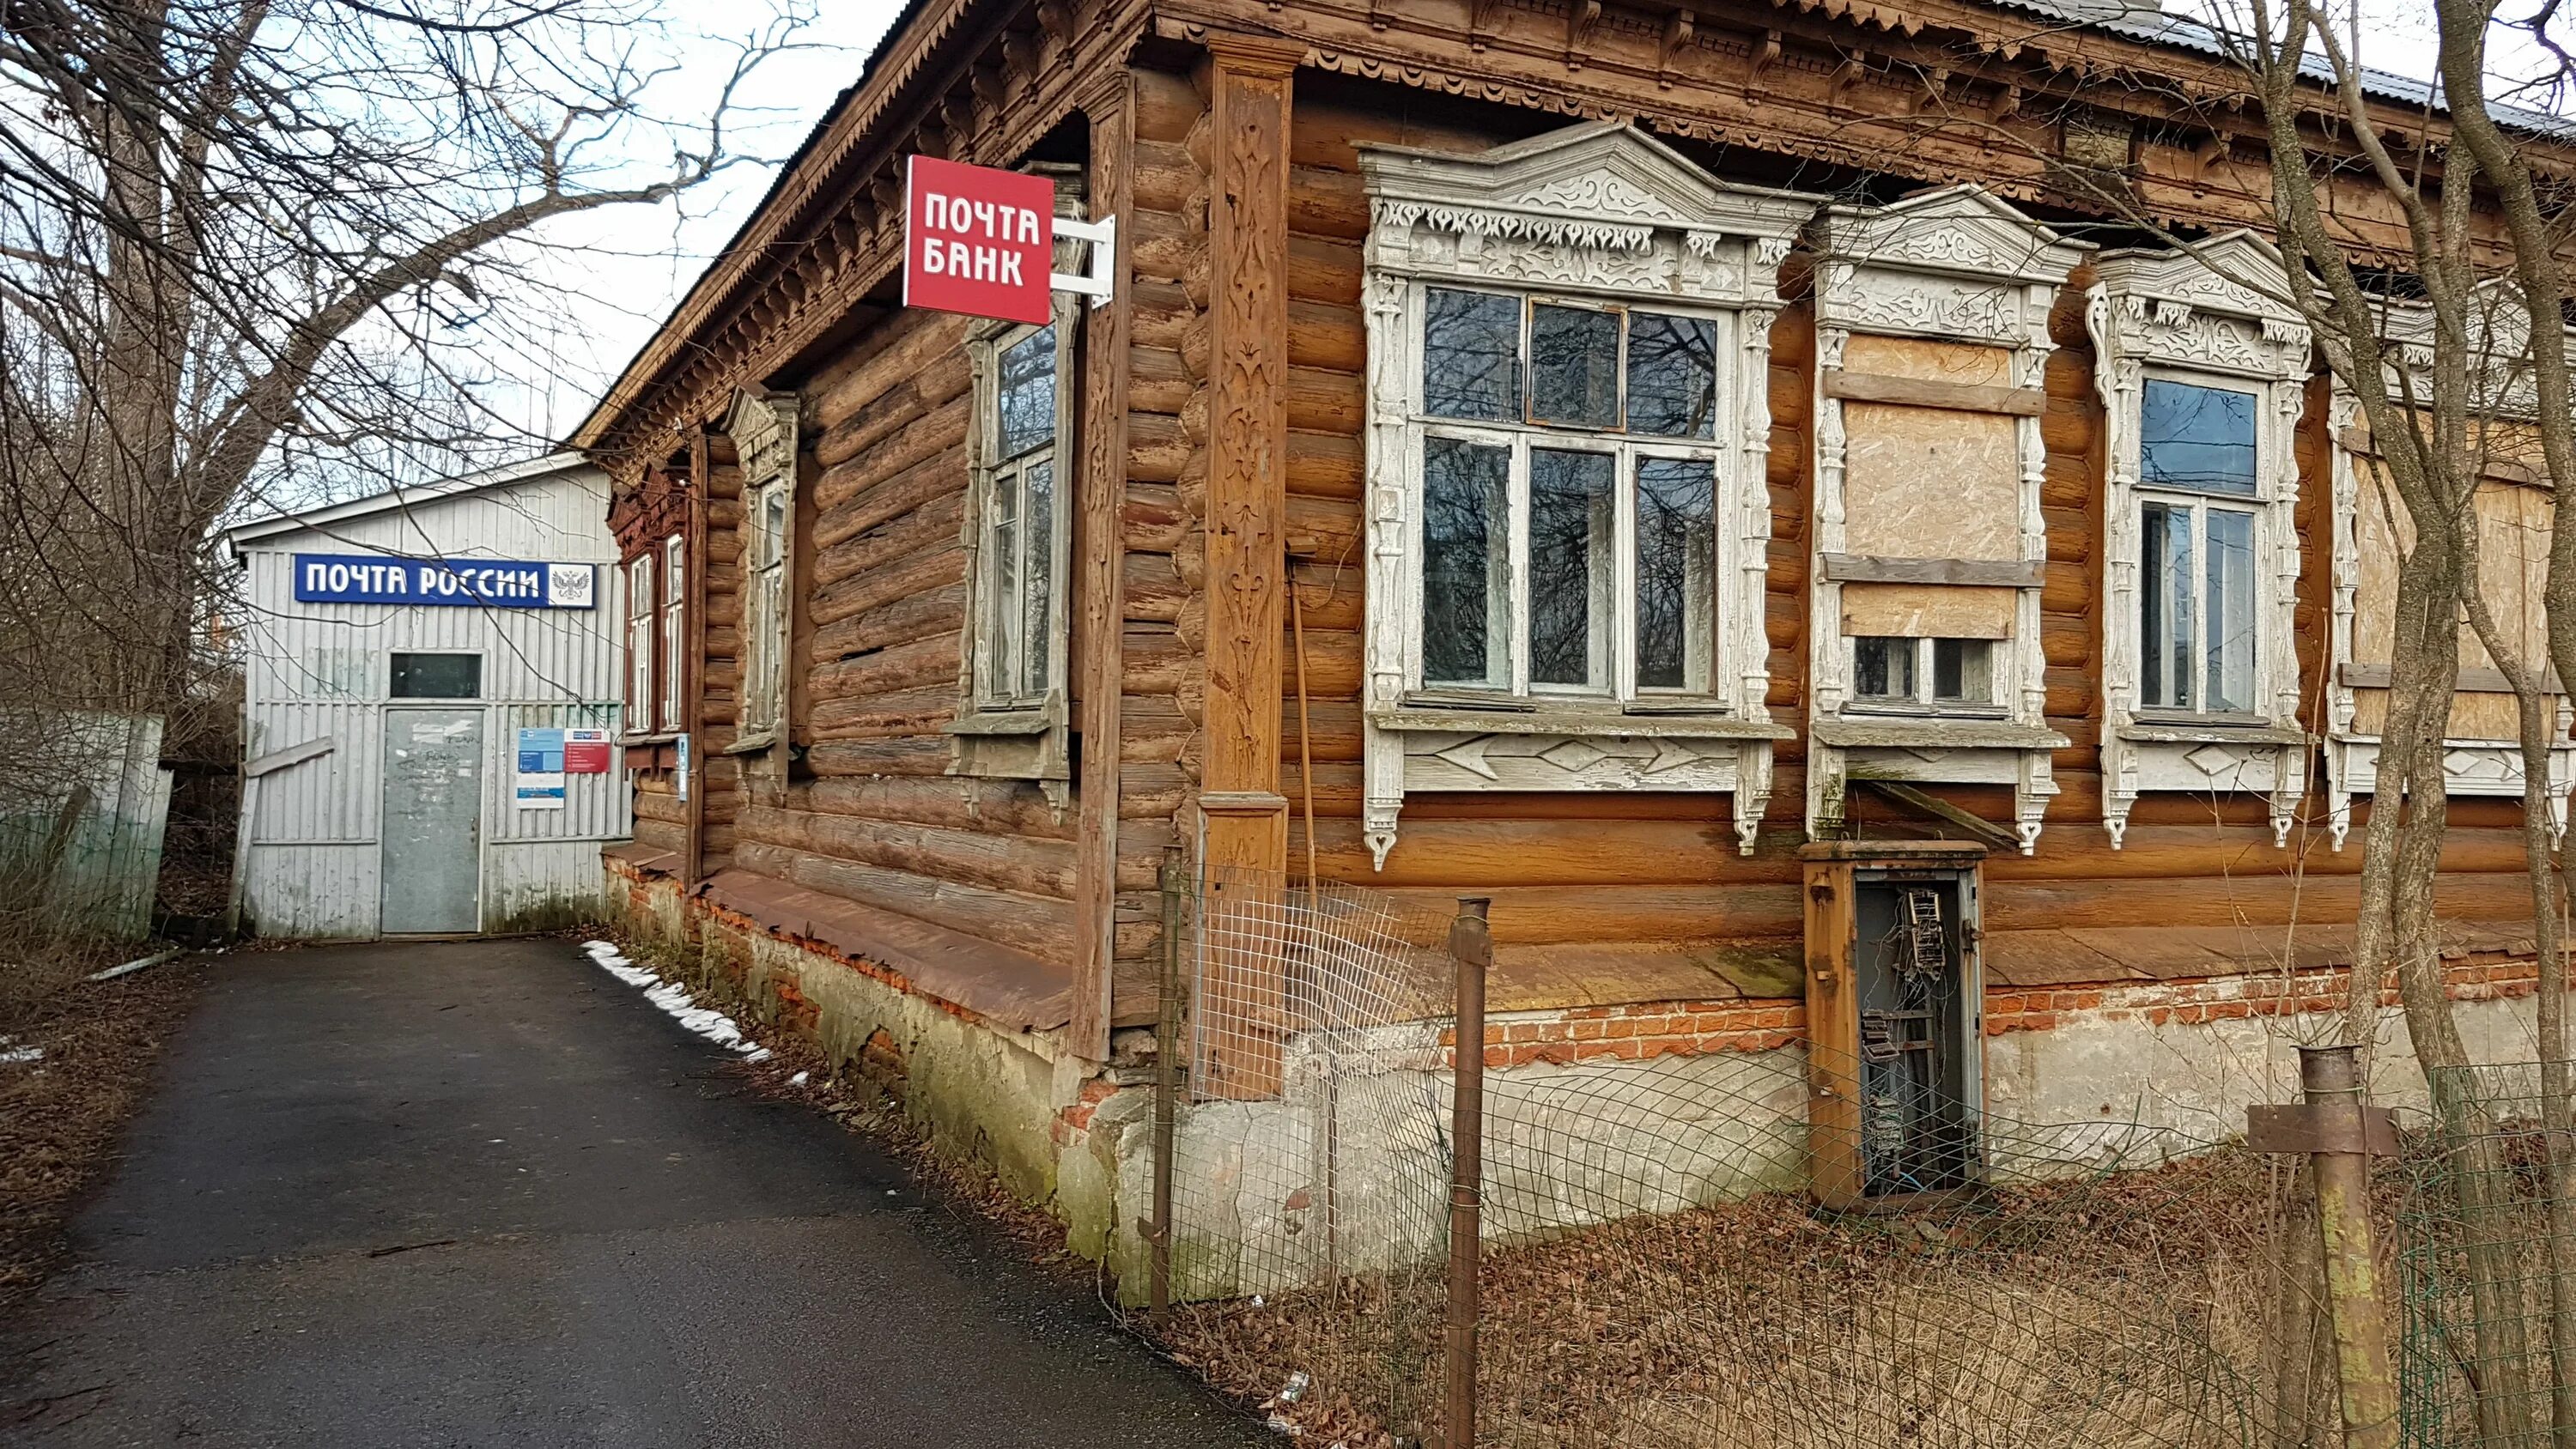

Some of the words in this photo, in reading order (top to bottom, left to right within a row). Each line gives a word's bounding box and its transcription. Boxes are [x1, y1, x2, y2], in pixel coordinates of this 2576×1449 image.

[926, 193, 1040, 245] ПОЧТА
[924, 237, 1024, 286] БАНК
[307, 563, 406, 594] ПОЧТА
[420, 567, 539, 597] РОССИИ
